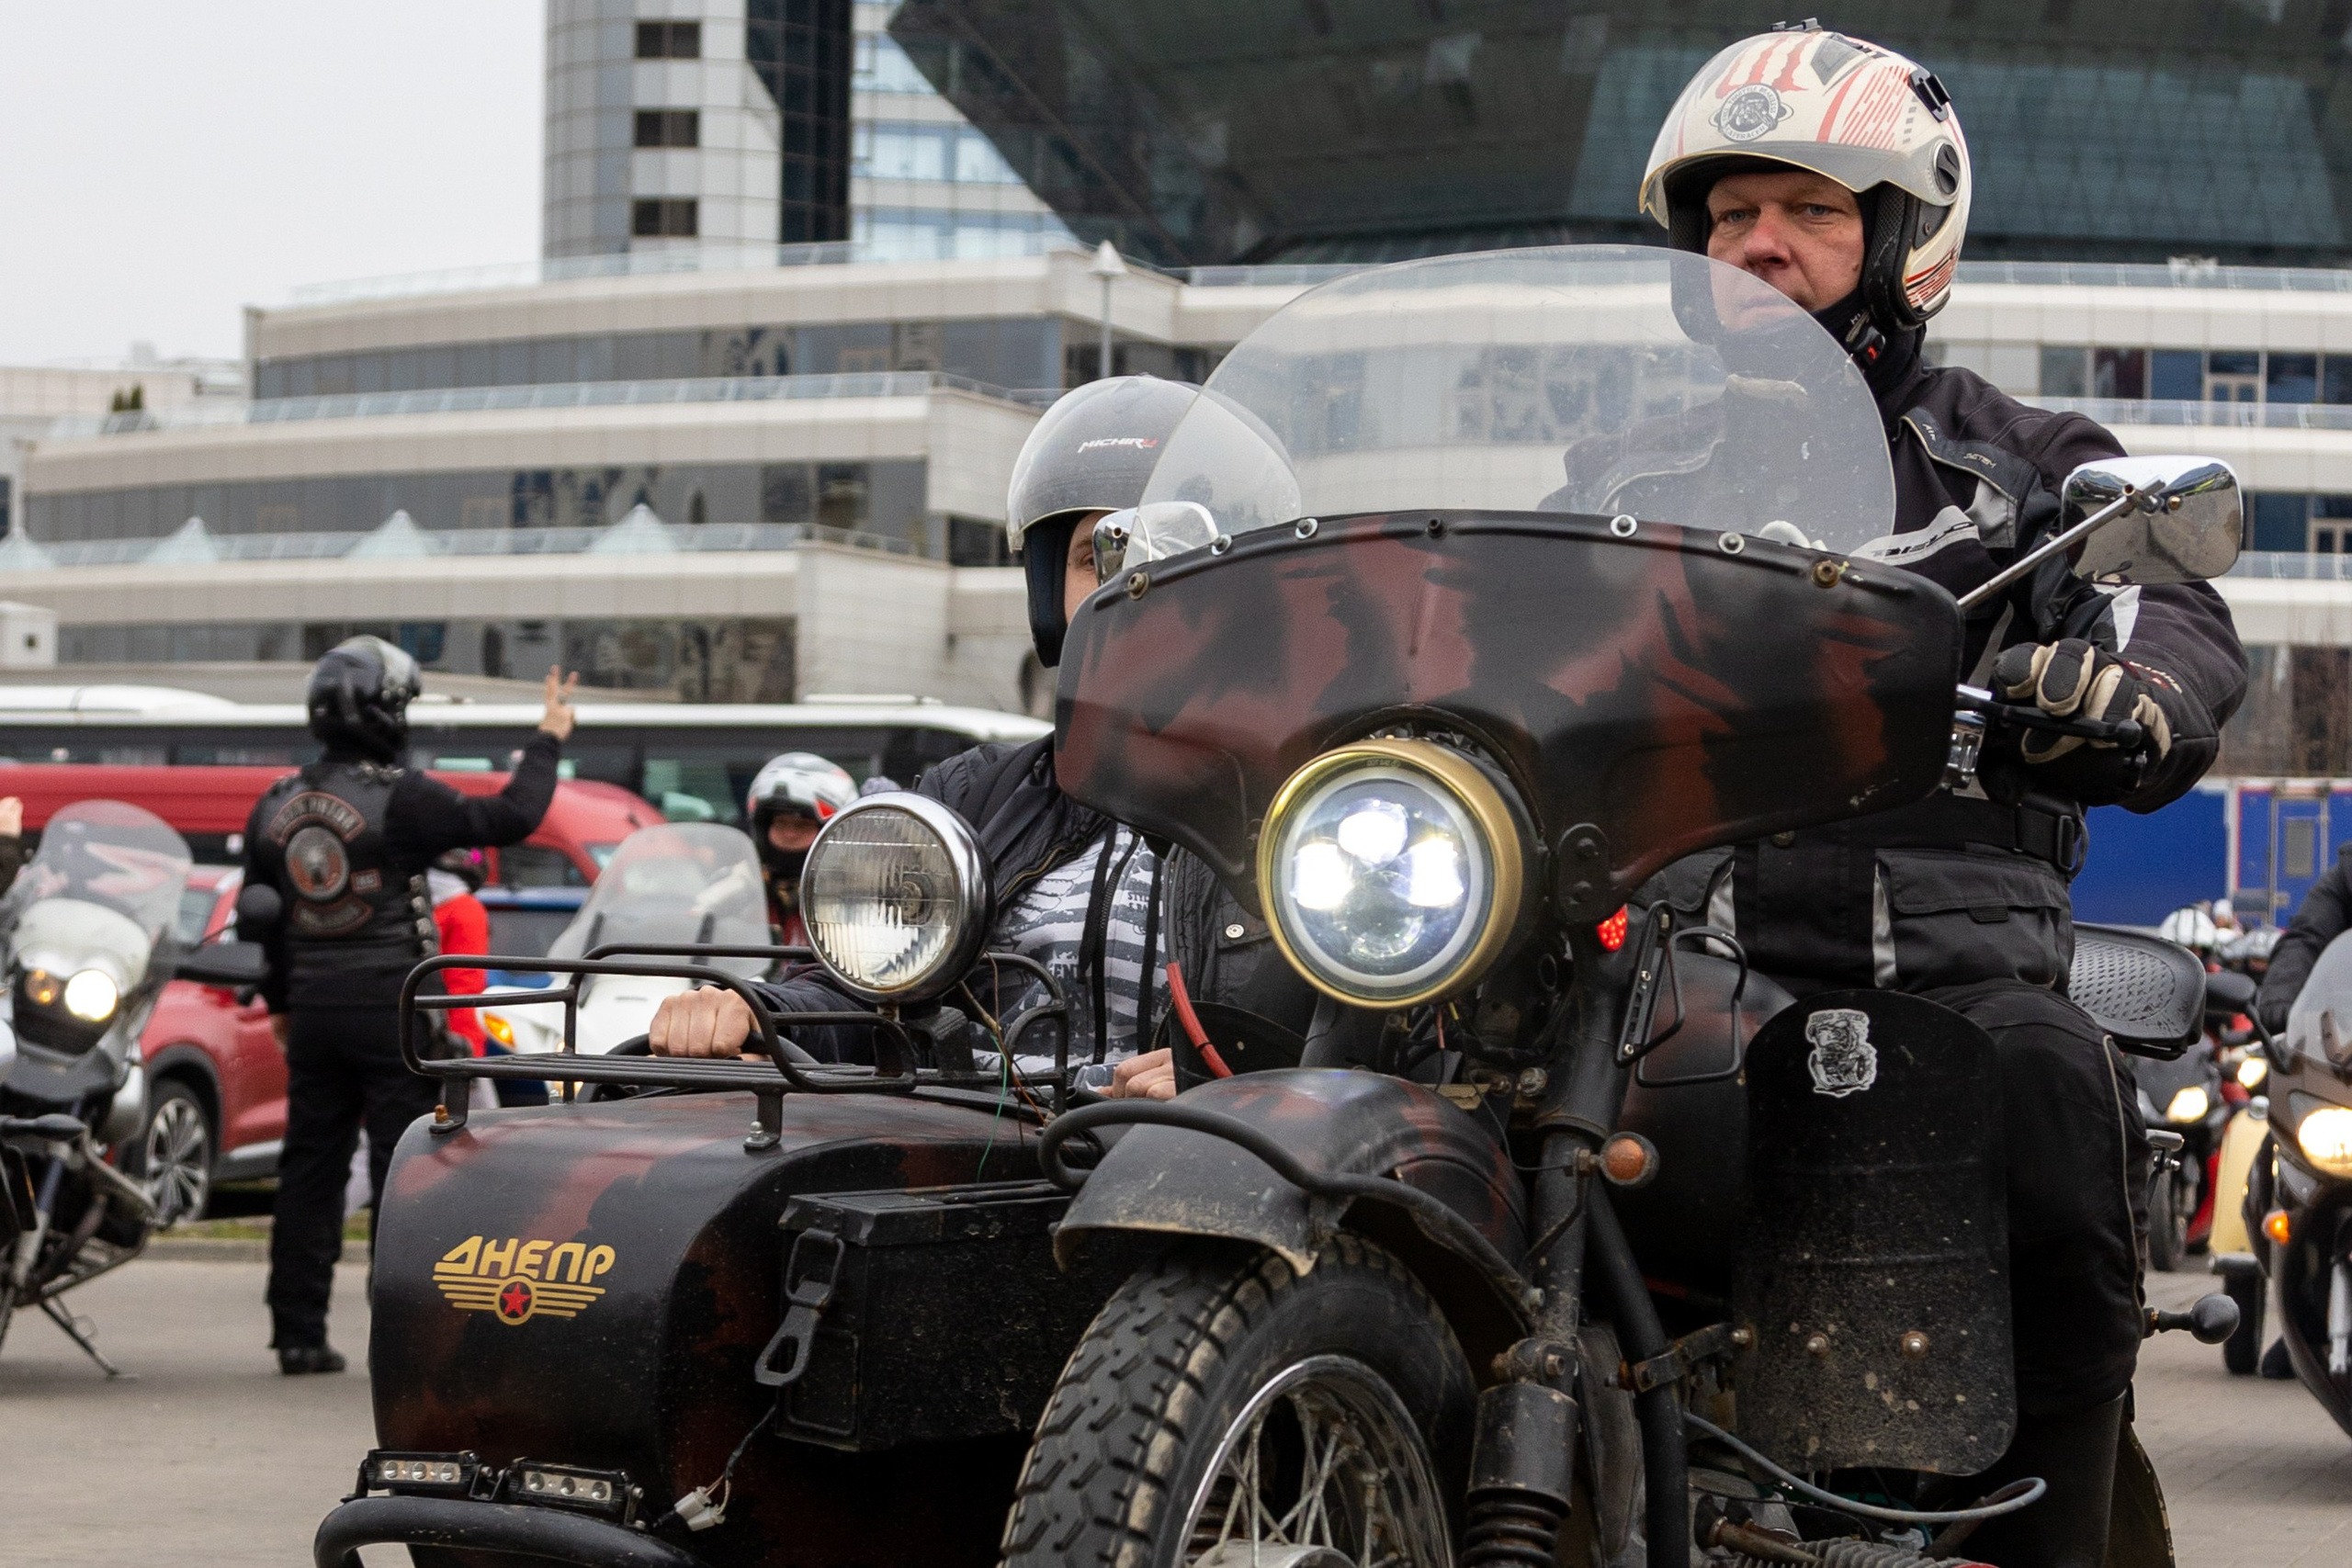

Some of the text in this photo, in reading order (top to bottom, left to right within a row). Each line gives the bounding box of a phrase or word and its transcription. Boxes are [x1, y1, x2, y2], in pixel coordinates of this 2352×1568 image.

[1922, 423, 1937, 442] AIR
[1127, 891, 1150, 902] STYL
[434, 1235, 616, 1284] ДНЕПР
